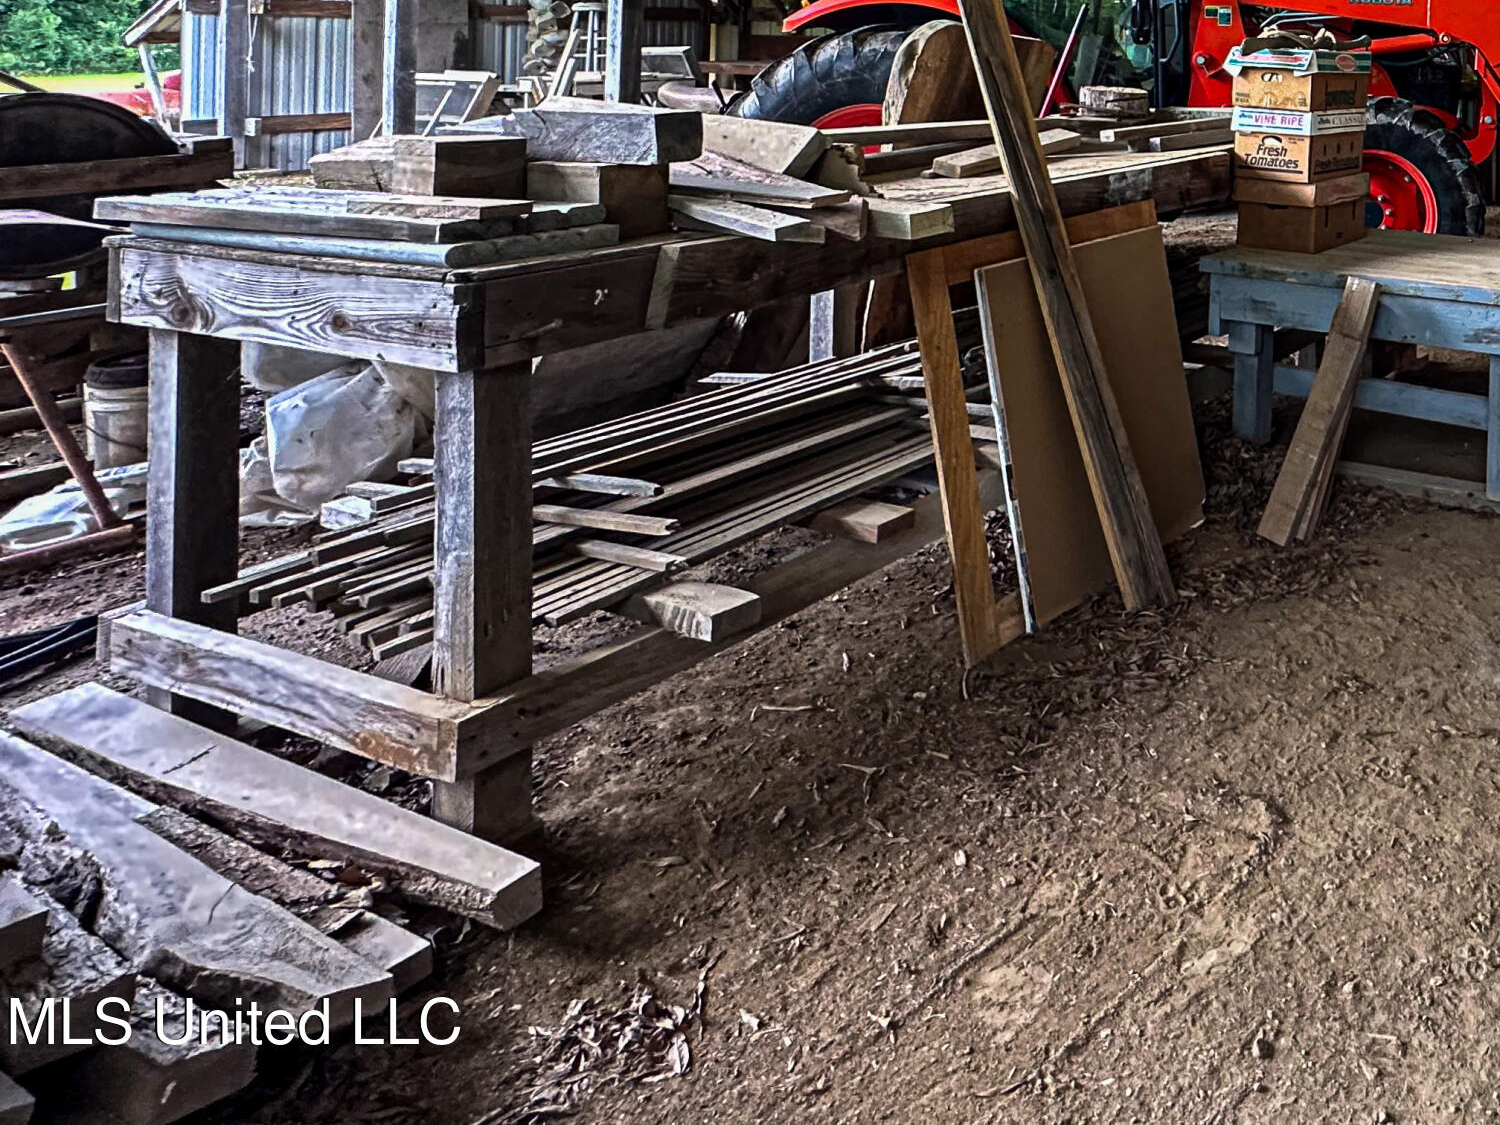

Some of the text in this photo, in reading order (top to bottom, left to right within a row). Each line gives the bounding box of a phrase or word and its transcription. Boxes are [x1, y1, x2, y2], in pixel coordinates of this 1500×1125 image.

[1254, 114, 1277, 124] VINE
[1280, 116, 1304, 127] RIPE
[1256, 144, 1288, 158] Fresh
[1244, 153, 1299, 169] Tomatoes
